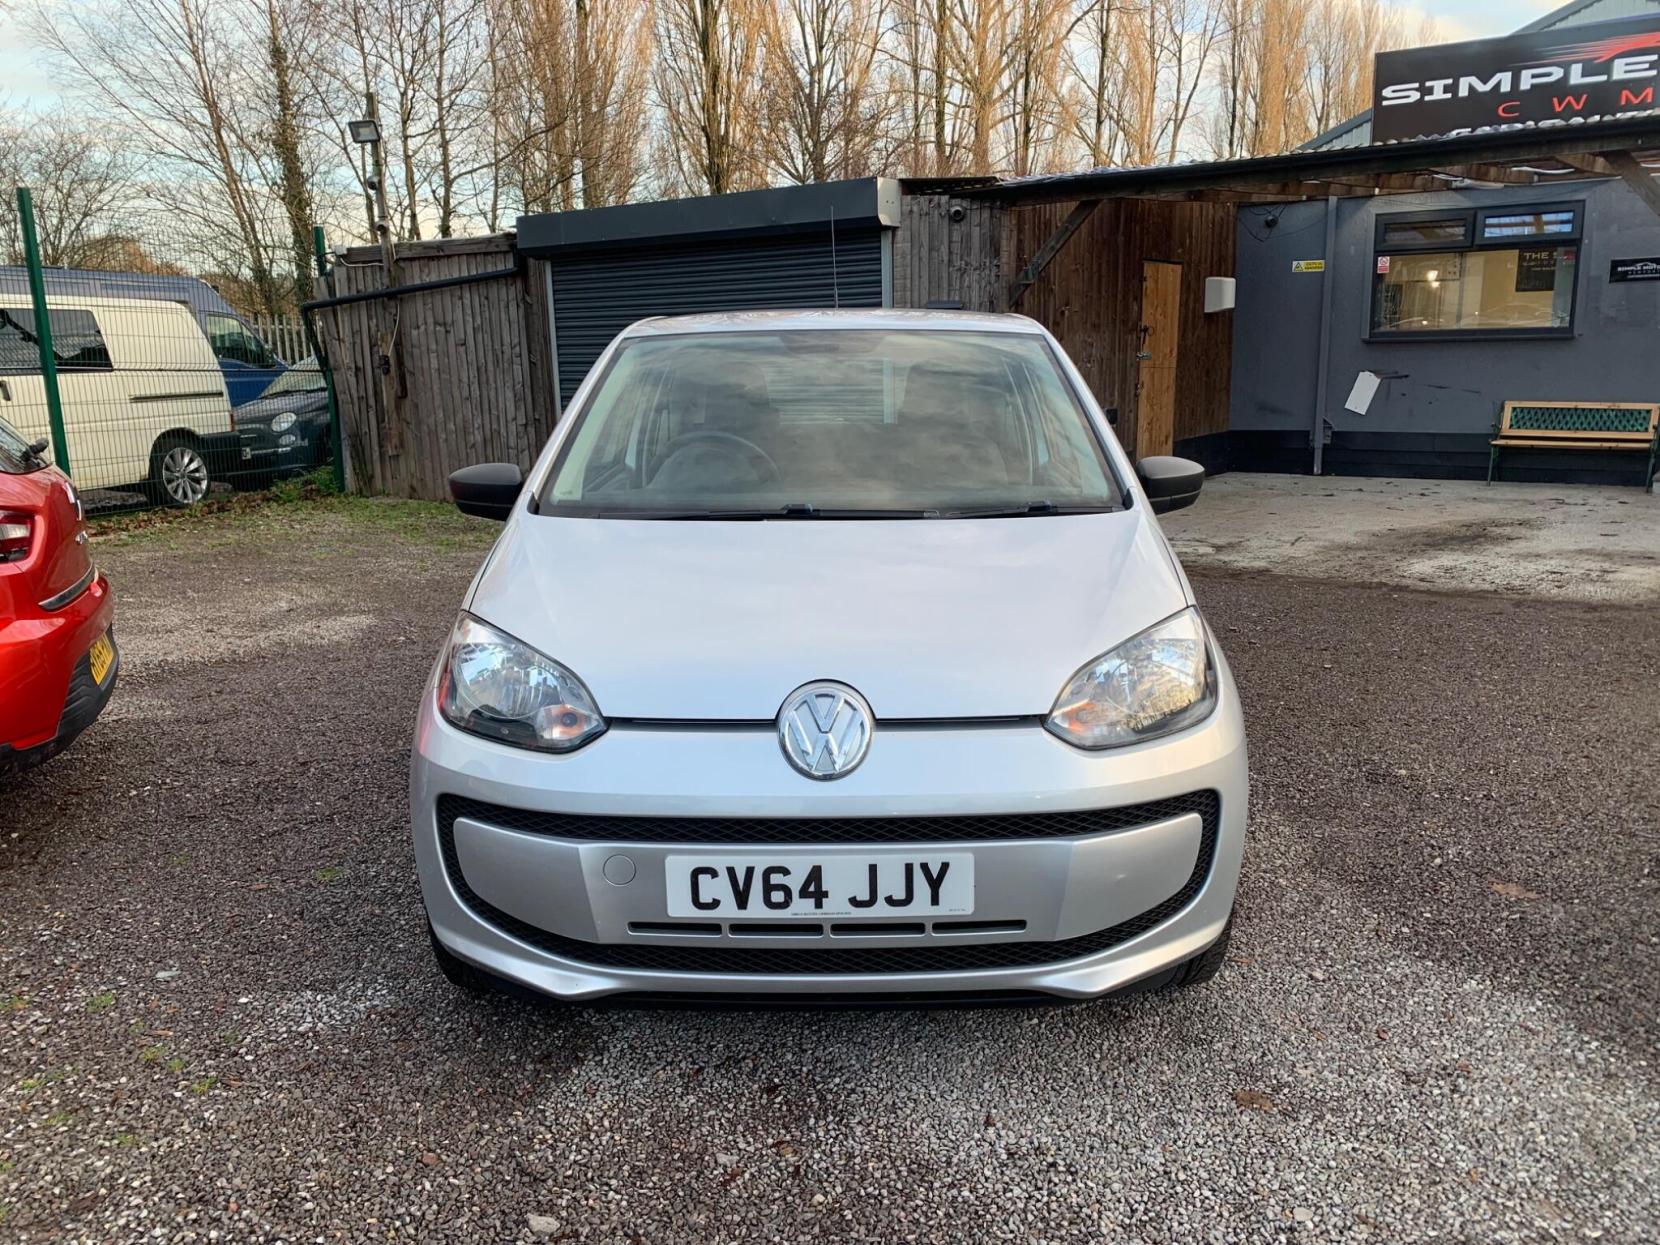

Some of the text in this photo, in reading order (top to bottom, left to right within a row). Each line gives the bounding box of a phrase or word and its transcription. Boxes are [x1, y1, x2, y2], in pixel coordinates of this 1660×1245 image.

[1381, 54, 1658, 106] SIMPLE
[1523, 251, 1550, 260] THE
[690, 862, 950, 911] CV64 JJY
